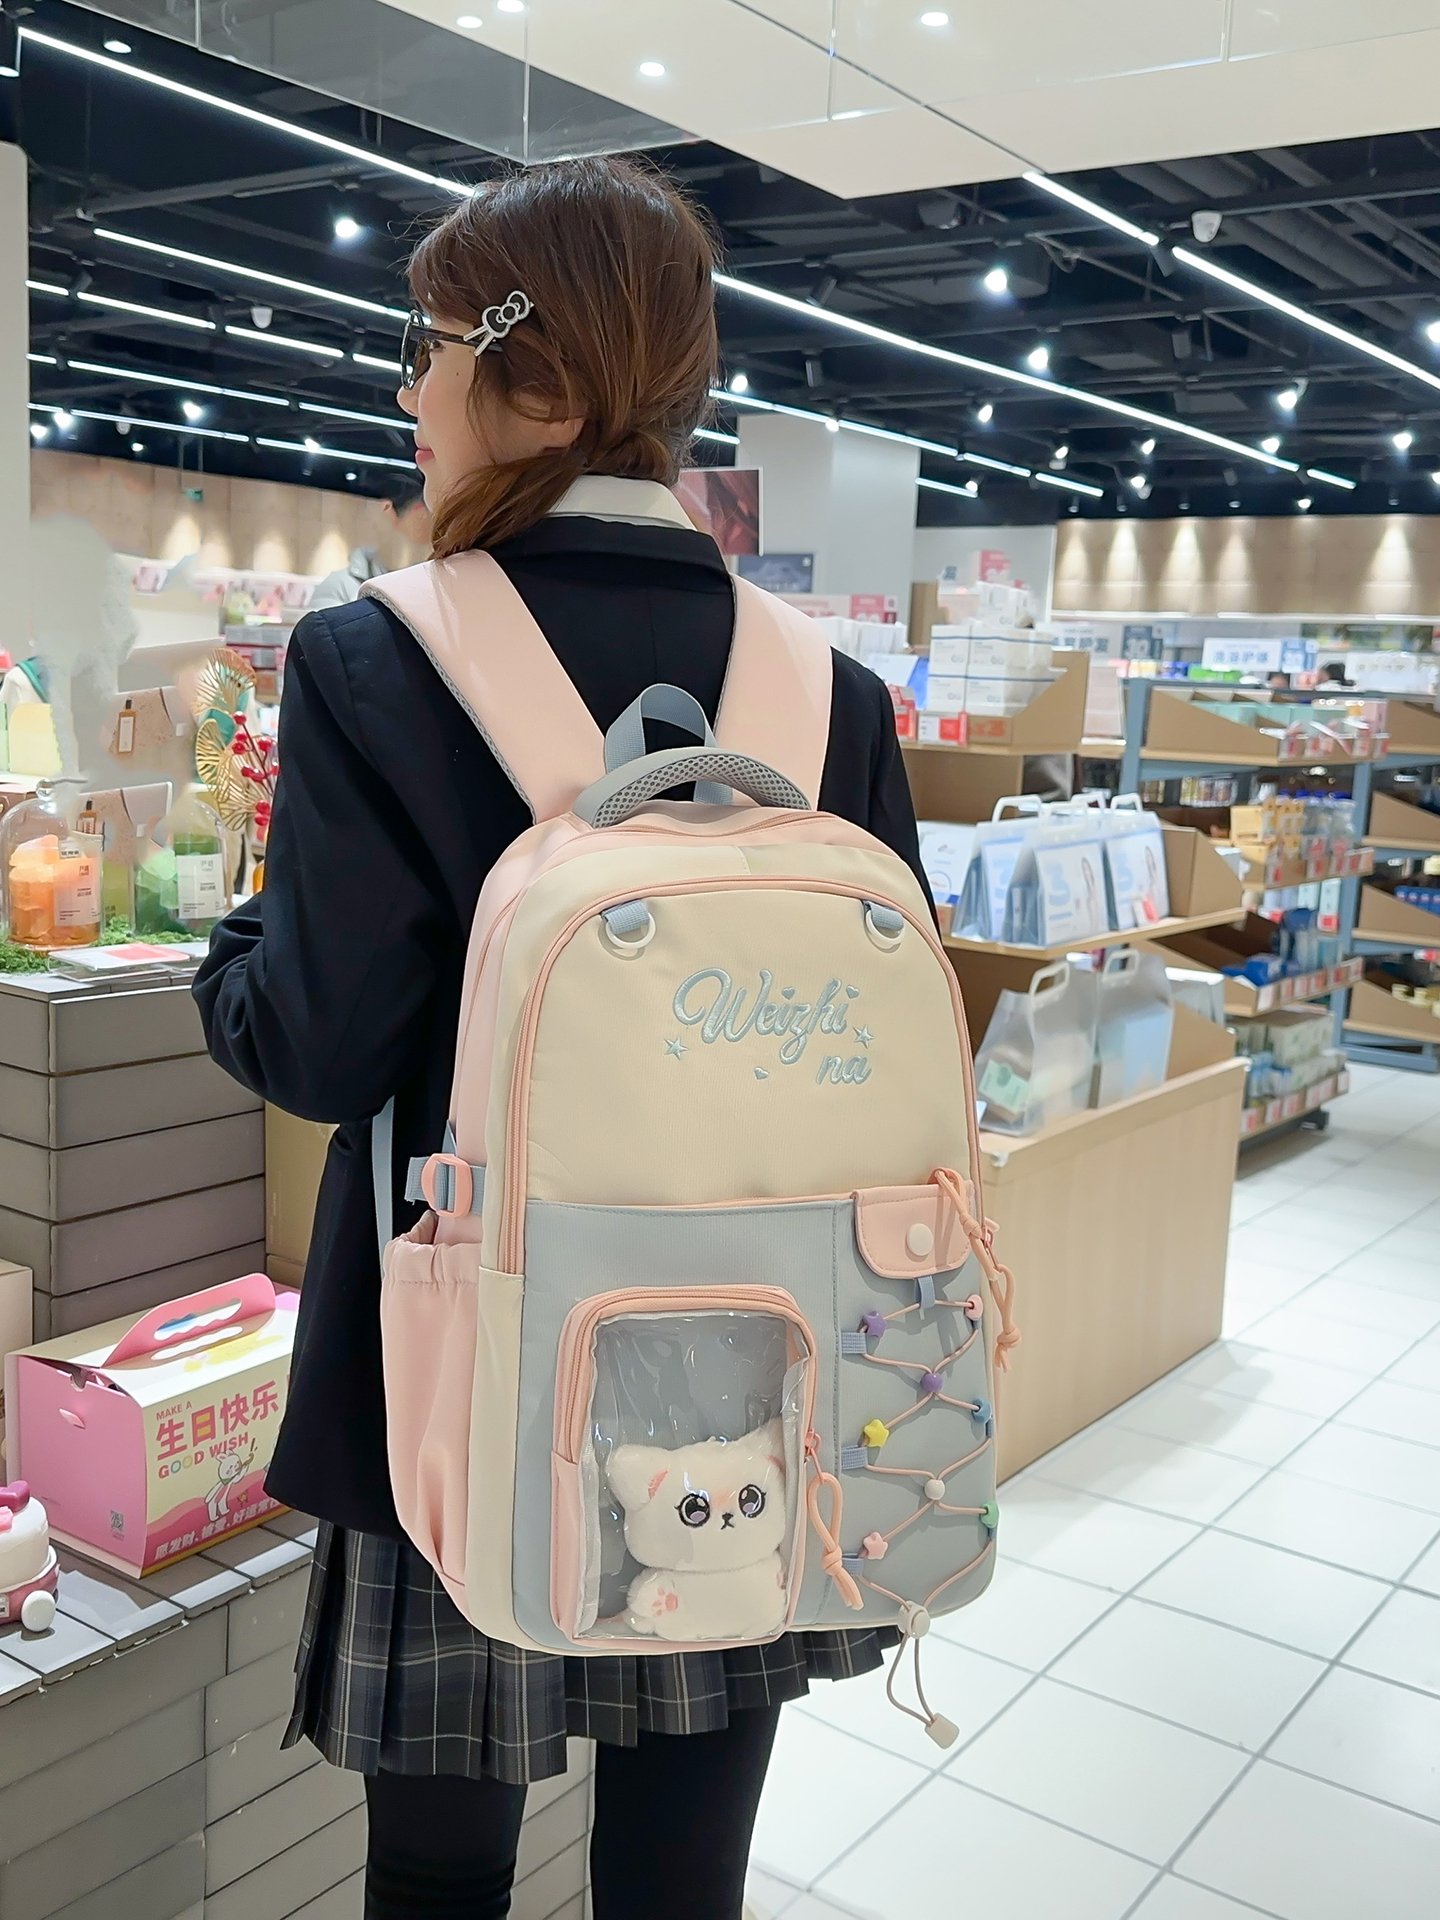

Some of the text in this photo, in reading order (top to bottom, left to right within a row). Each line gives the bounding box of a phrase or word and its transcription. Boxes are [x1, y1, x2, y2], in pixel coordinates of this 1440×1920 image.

[673, 967, 860, 1065] Weizhi
[816, 1055, 872, 1086] na
[156, 1401, 193, 1421] MAKE A
[156, 1380, 279, 1461] 生日快乐
[158, 1432, 248, 1479] GOOD WISH
